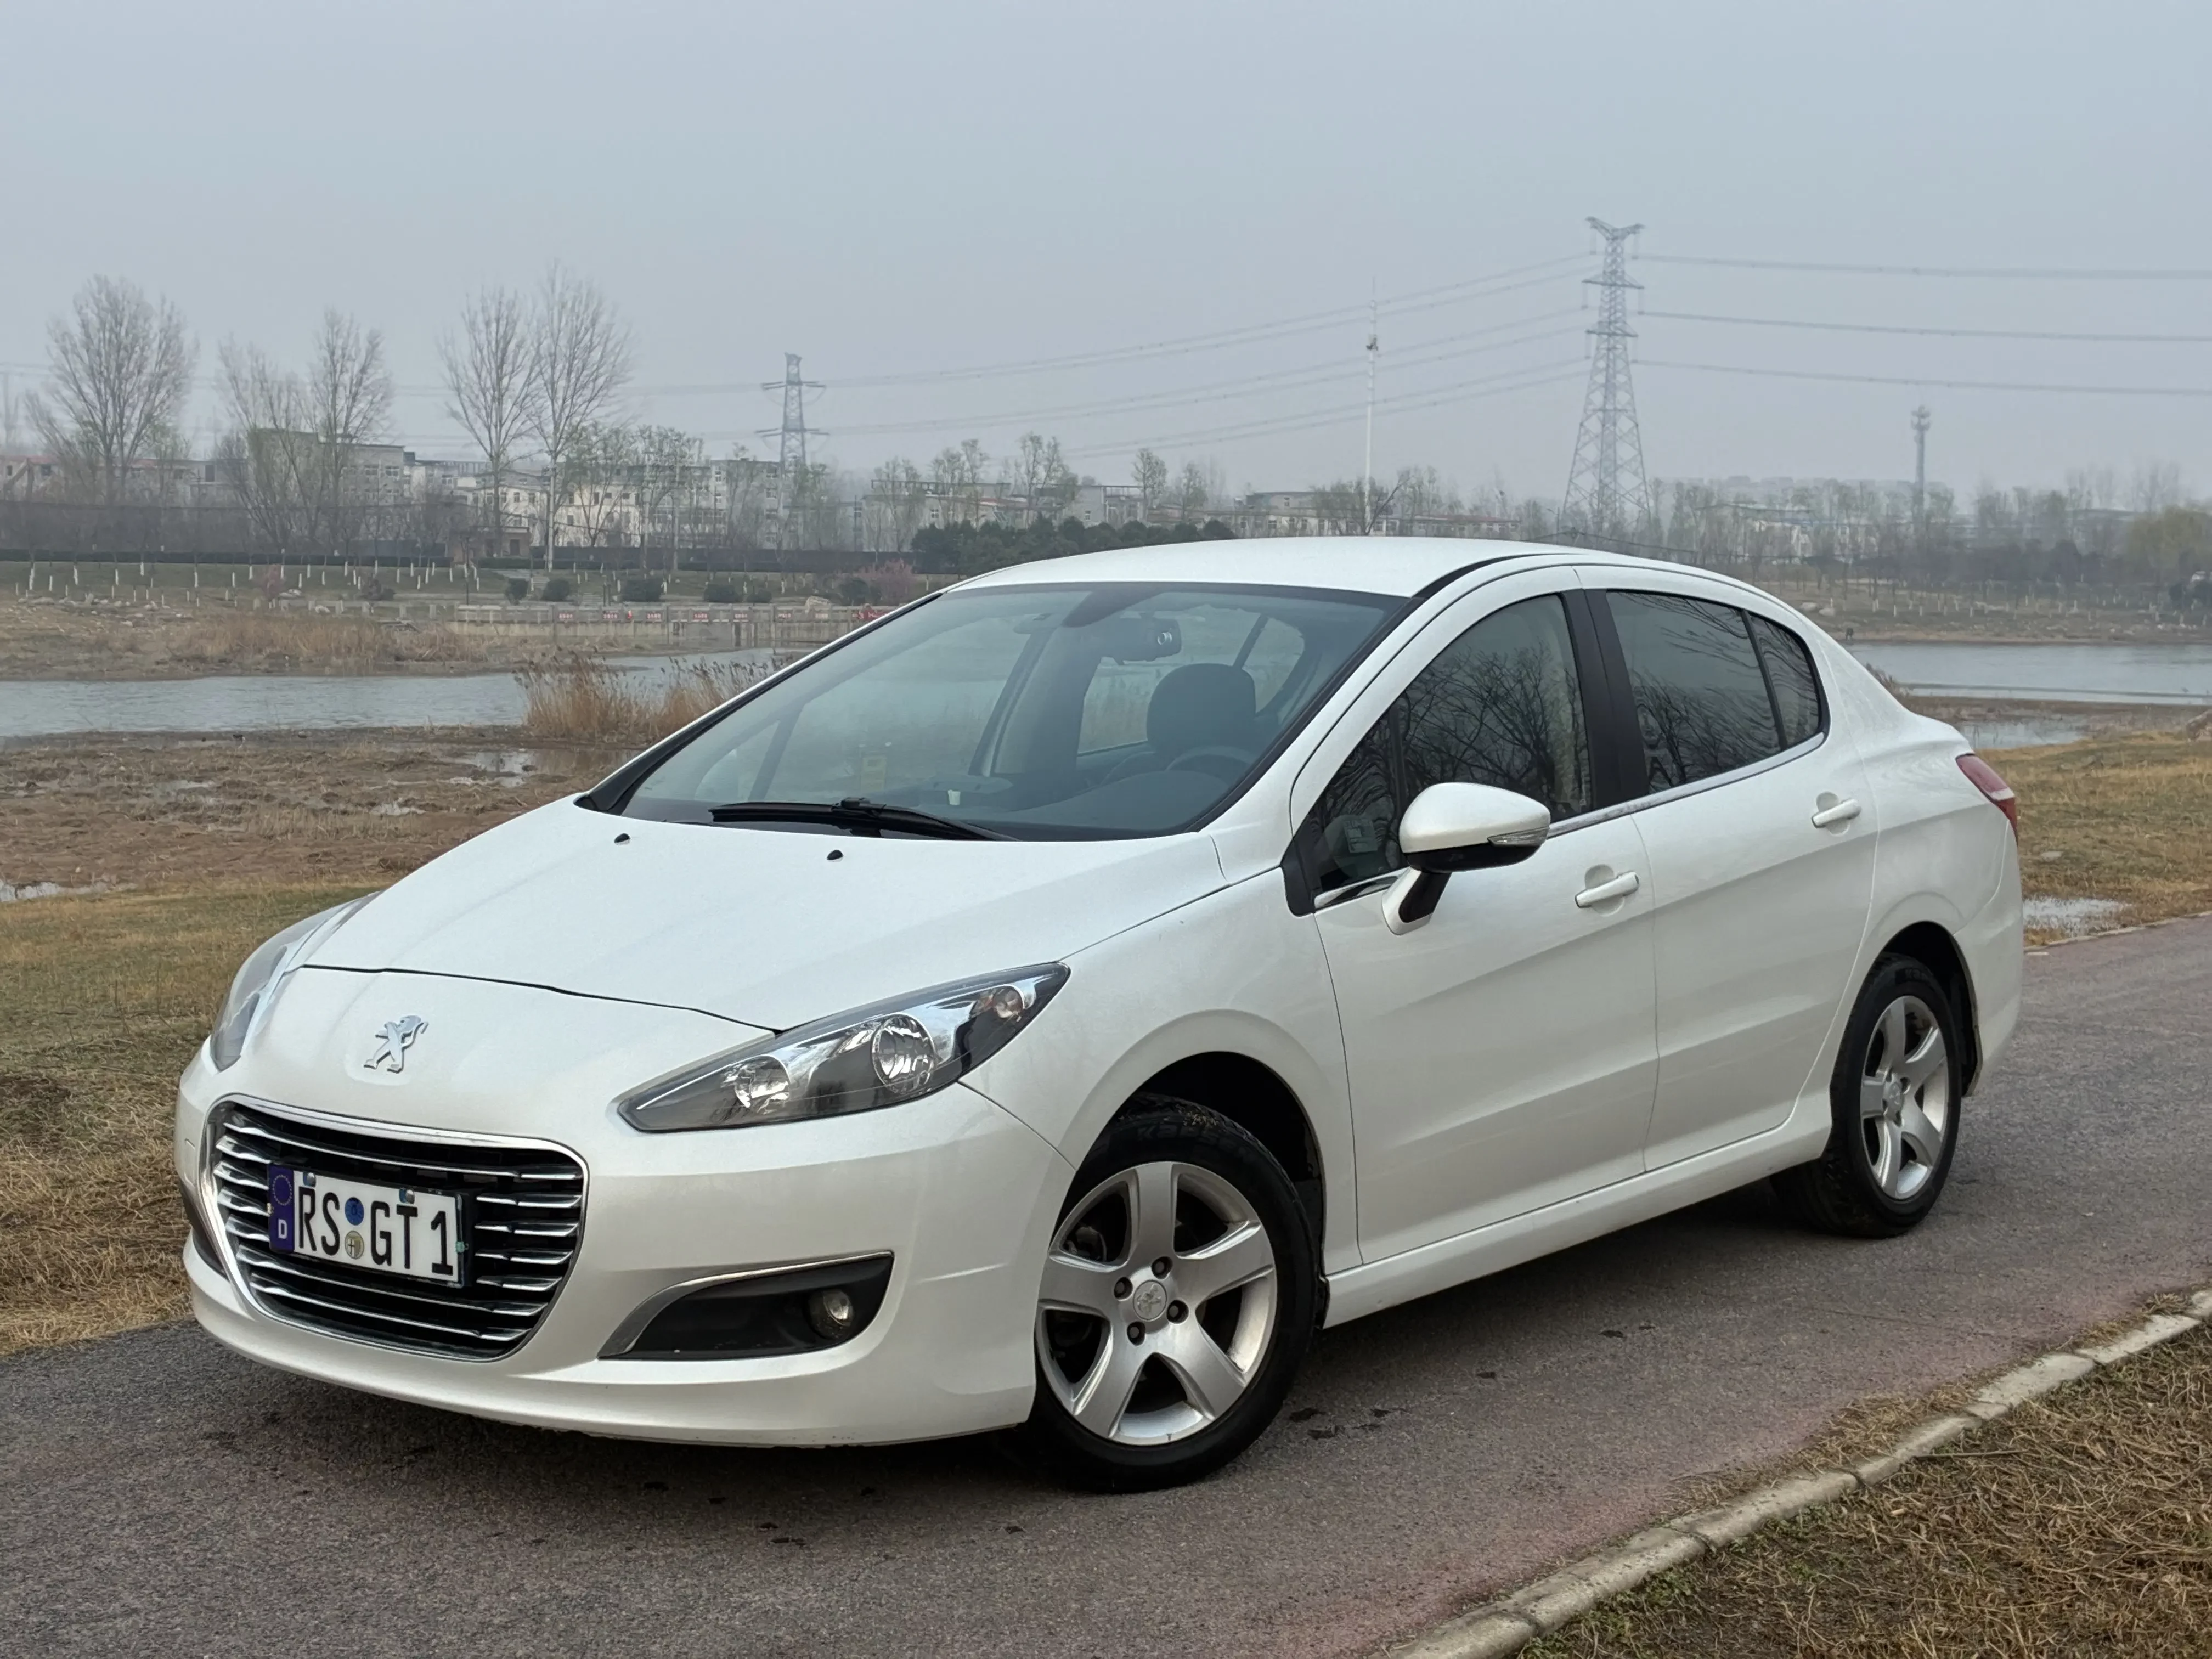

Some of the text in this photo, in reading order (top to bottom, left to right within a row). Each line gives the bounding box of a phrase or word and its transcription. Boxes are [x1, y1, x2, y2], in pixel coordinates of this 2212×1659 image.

[278, 1218, 288, 1239] D
[298, 1186, 453, 1276] RS GT 1
